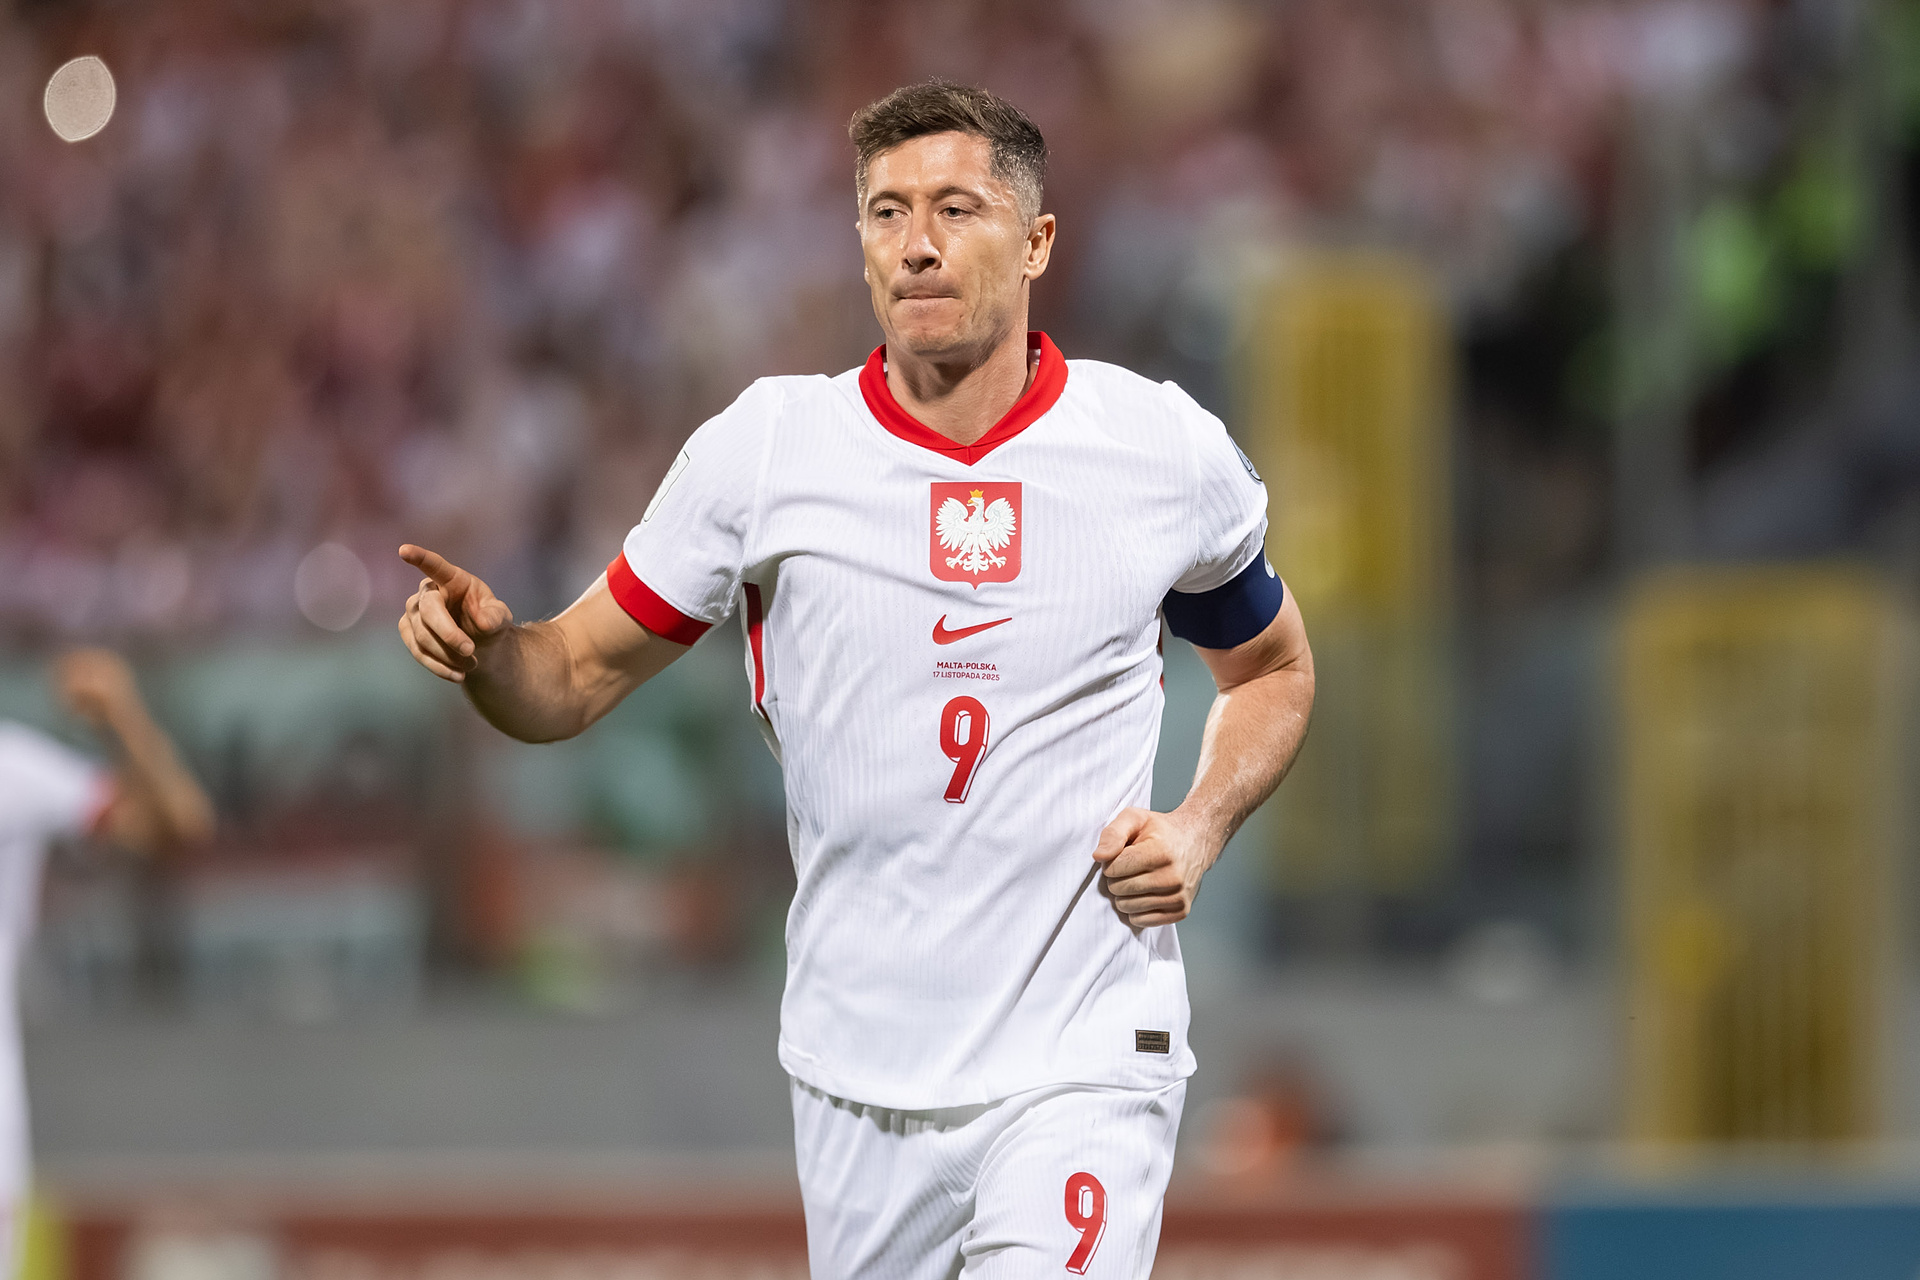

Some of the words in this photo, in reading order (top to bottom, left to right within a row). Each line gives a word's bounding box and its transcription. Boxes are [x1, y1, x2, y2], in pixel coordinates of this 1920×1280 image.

[936, 661, 997, 671] MALTA-POLSKA
[941, 671, 981, 679] LISTOPADA
[981, 673, 1000, 681] 2025
[939, 695, 991, 804] 9
[1064, 1171, 1108, 1276] 9
